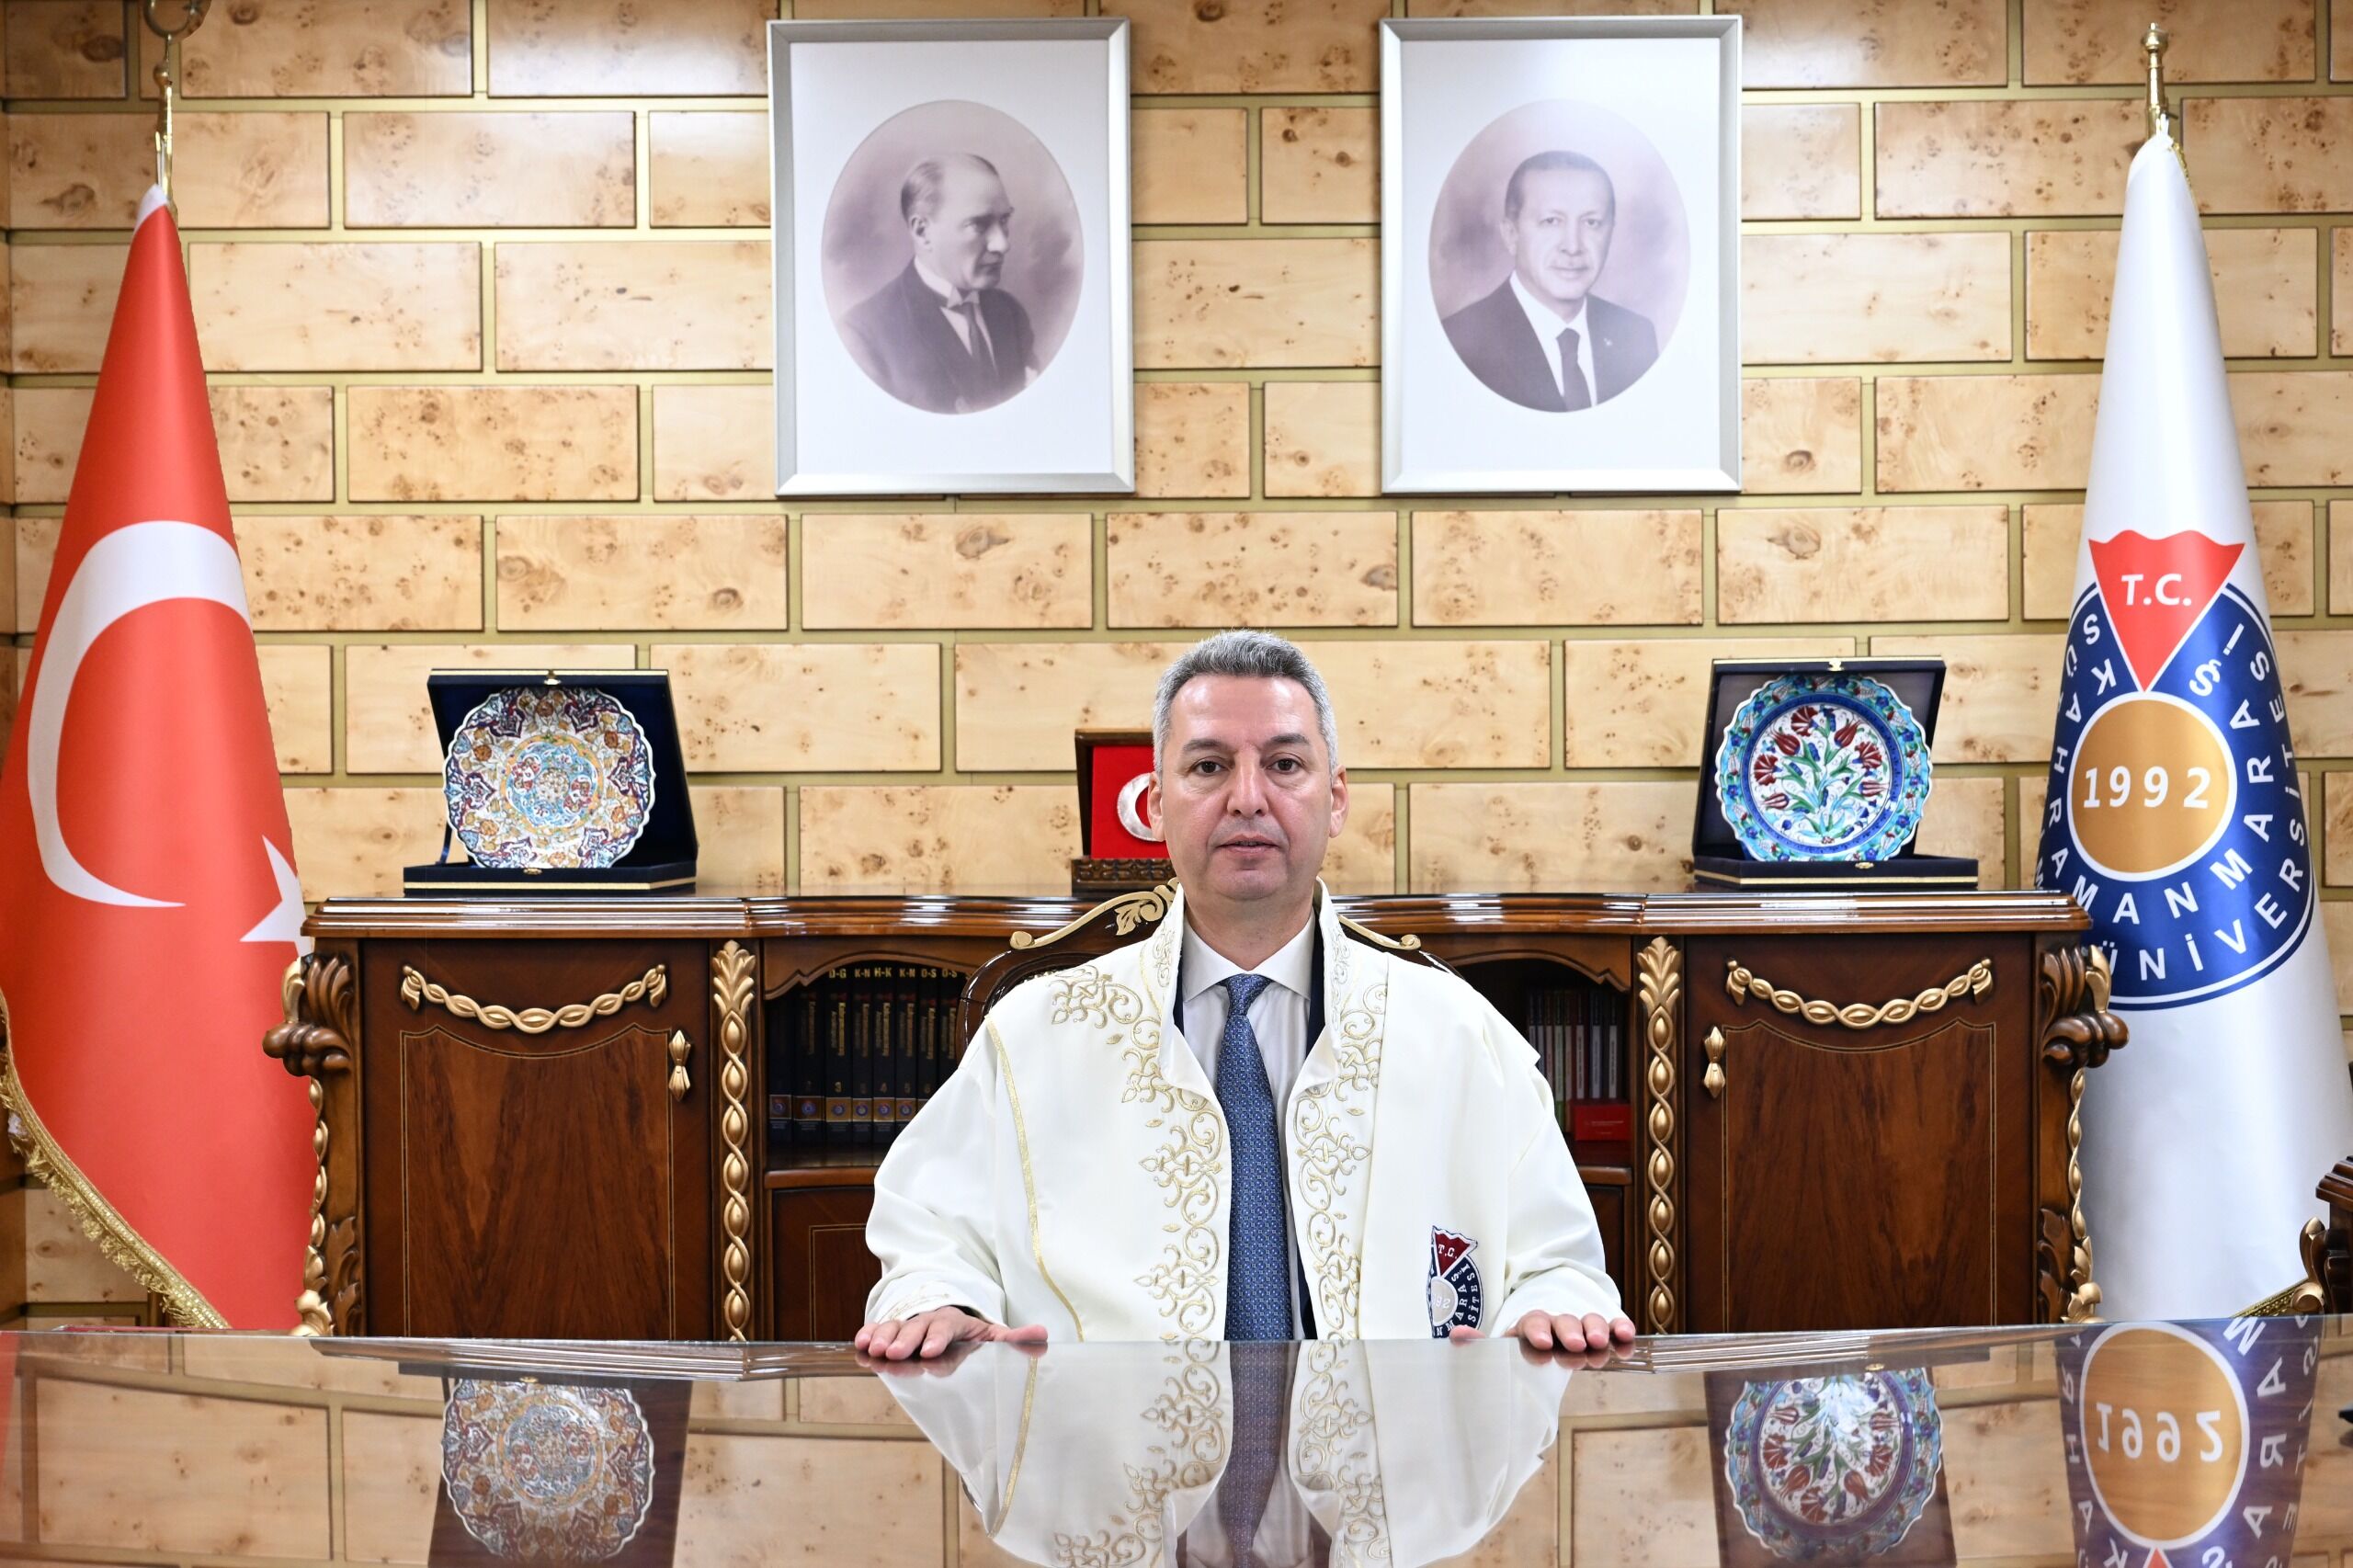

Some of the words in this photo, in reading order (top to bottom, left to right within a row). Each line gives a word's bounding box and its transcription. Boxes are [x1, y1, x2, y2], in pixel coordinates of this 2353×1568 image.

[2120, 573, 2193, 608] T.C.
[2049, 657, 2275, 926] KAHRAMANMARAŞ
[2082, 766, 2212, 810] 1992
[1438, 1244, 1458, 1259] T.C.
